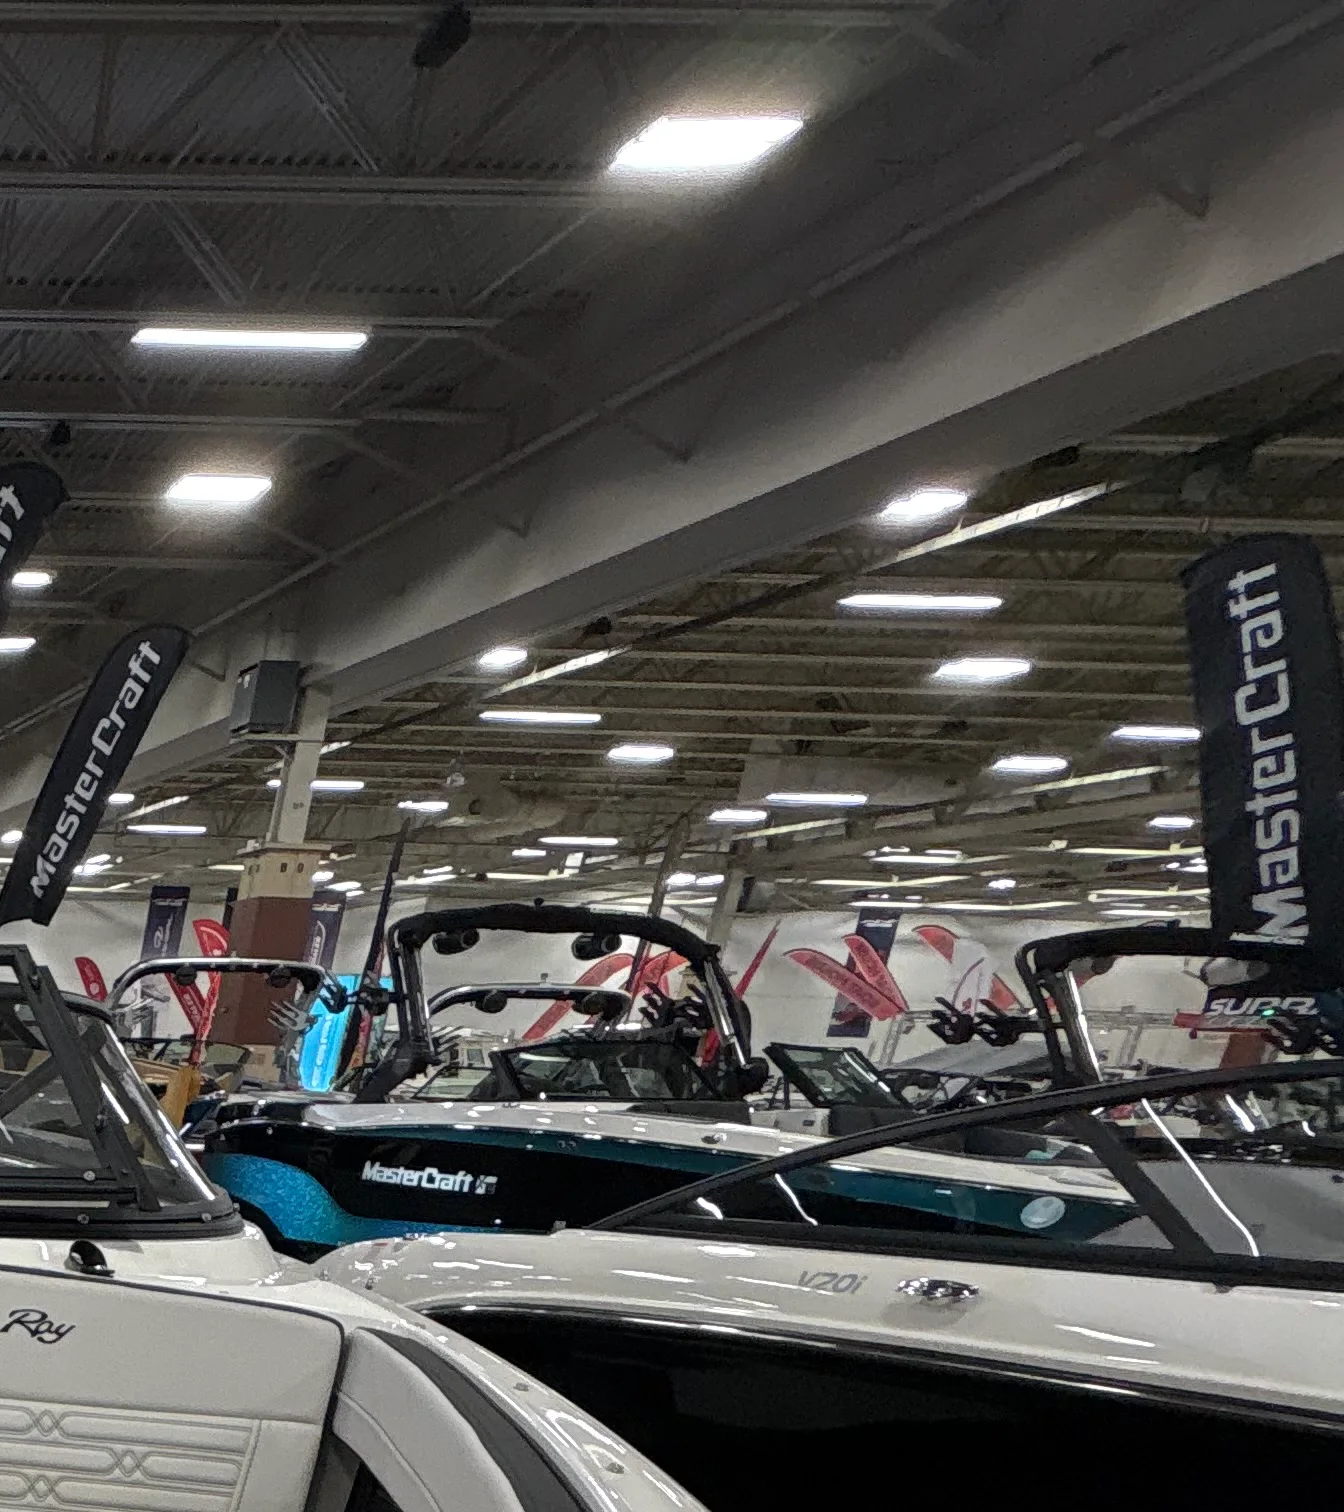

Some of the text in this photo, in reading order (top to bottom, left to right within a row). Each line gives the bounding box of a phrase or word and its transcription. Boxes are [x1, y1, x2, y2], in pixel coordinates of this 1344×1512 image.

[29, 640, 161, 898] MasterCraft
[1228, 561, 1310, 946] MasterCraft
[362, 1160, 474, 1193] MasterCraft
